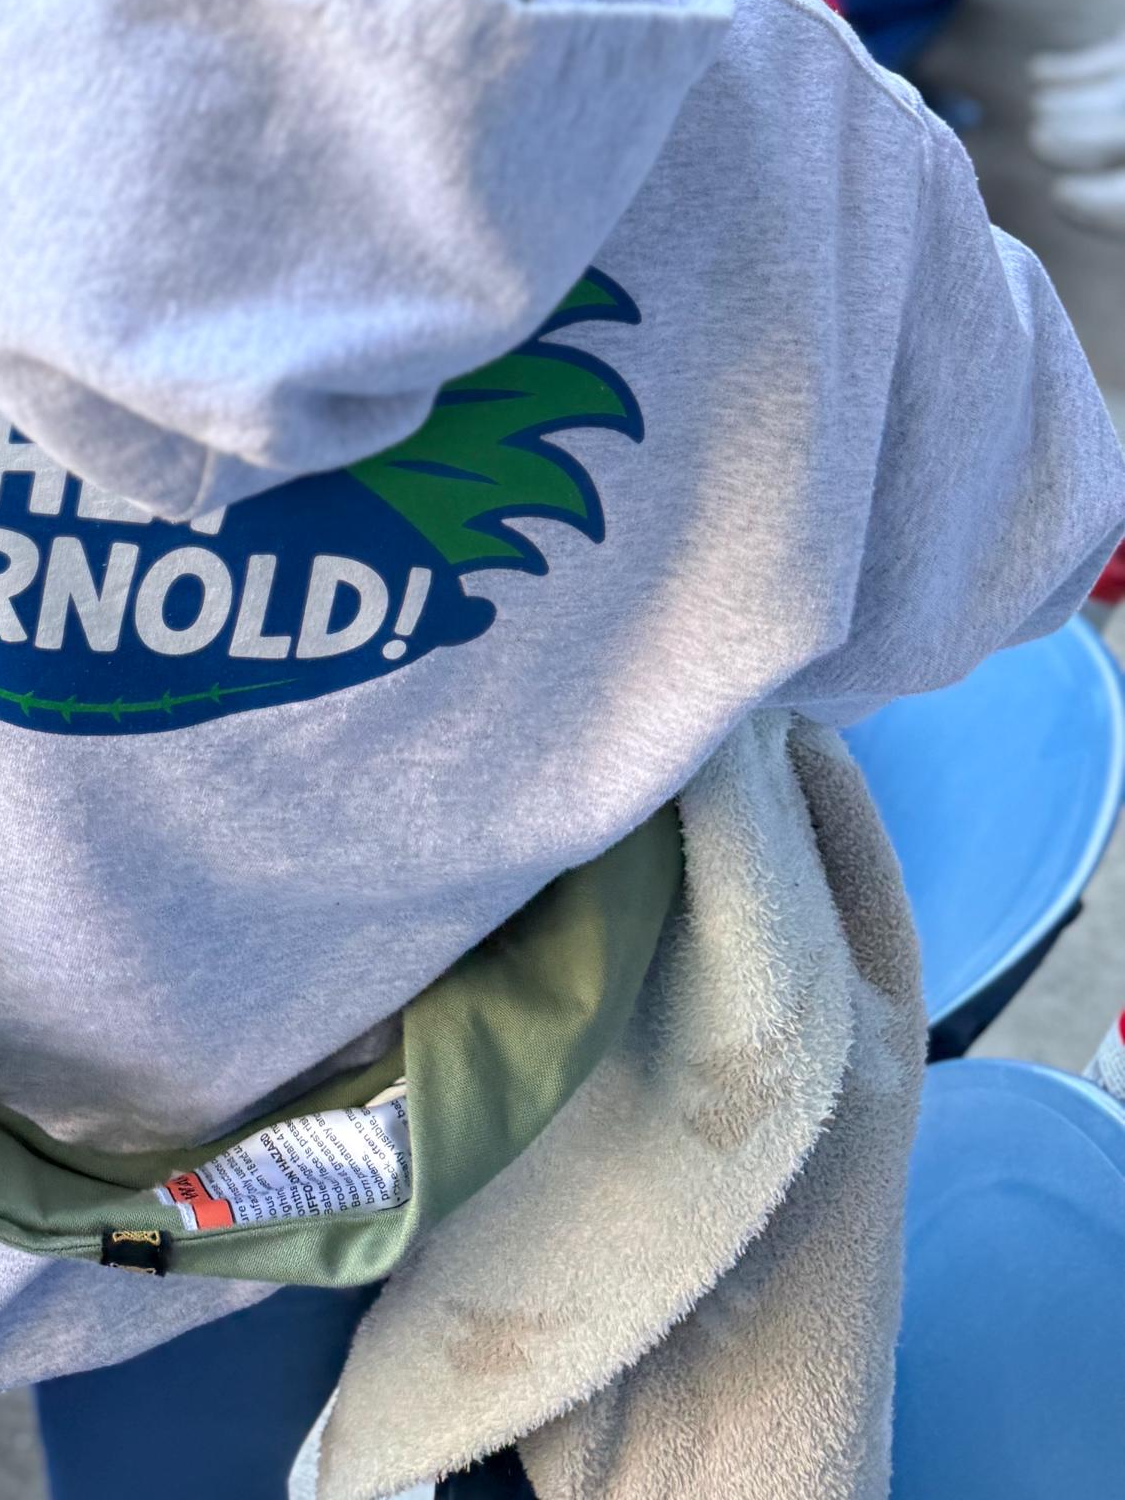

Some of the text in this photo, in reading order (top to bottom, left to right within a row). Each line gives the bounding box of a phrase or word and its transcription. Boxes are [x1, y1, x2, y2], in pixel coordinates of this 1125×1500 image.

[275, 1133, 284, 1141] 4
[352, 1120, 365, 1133] to
[259, 1132, 289, 1171] HAZARD
[280, 1140, 299, 1163] than
[302, 1146, 313, 1157] is
[307, 1130, 343, 1172] greatest
[361, 1132, 386, 1162] often
